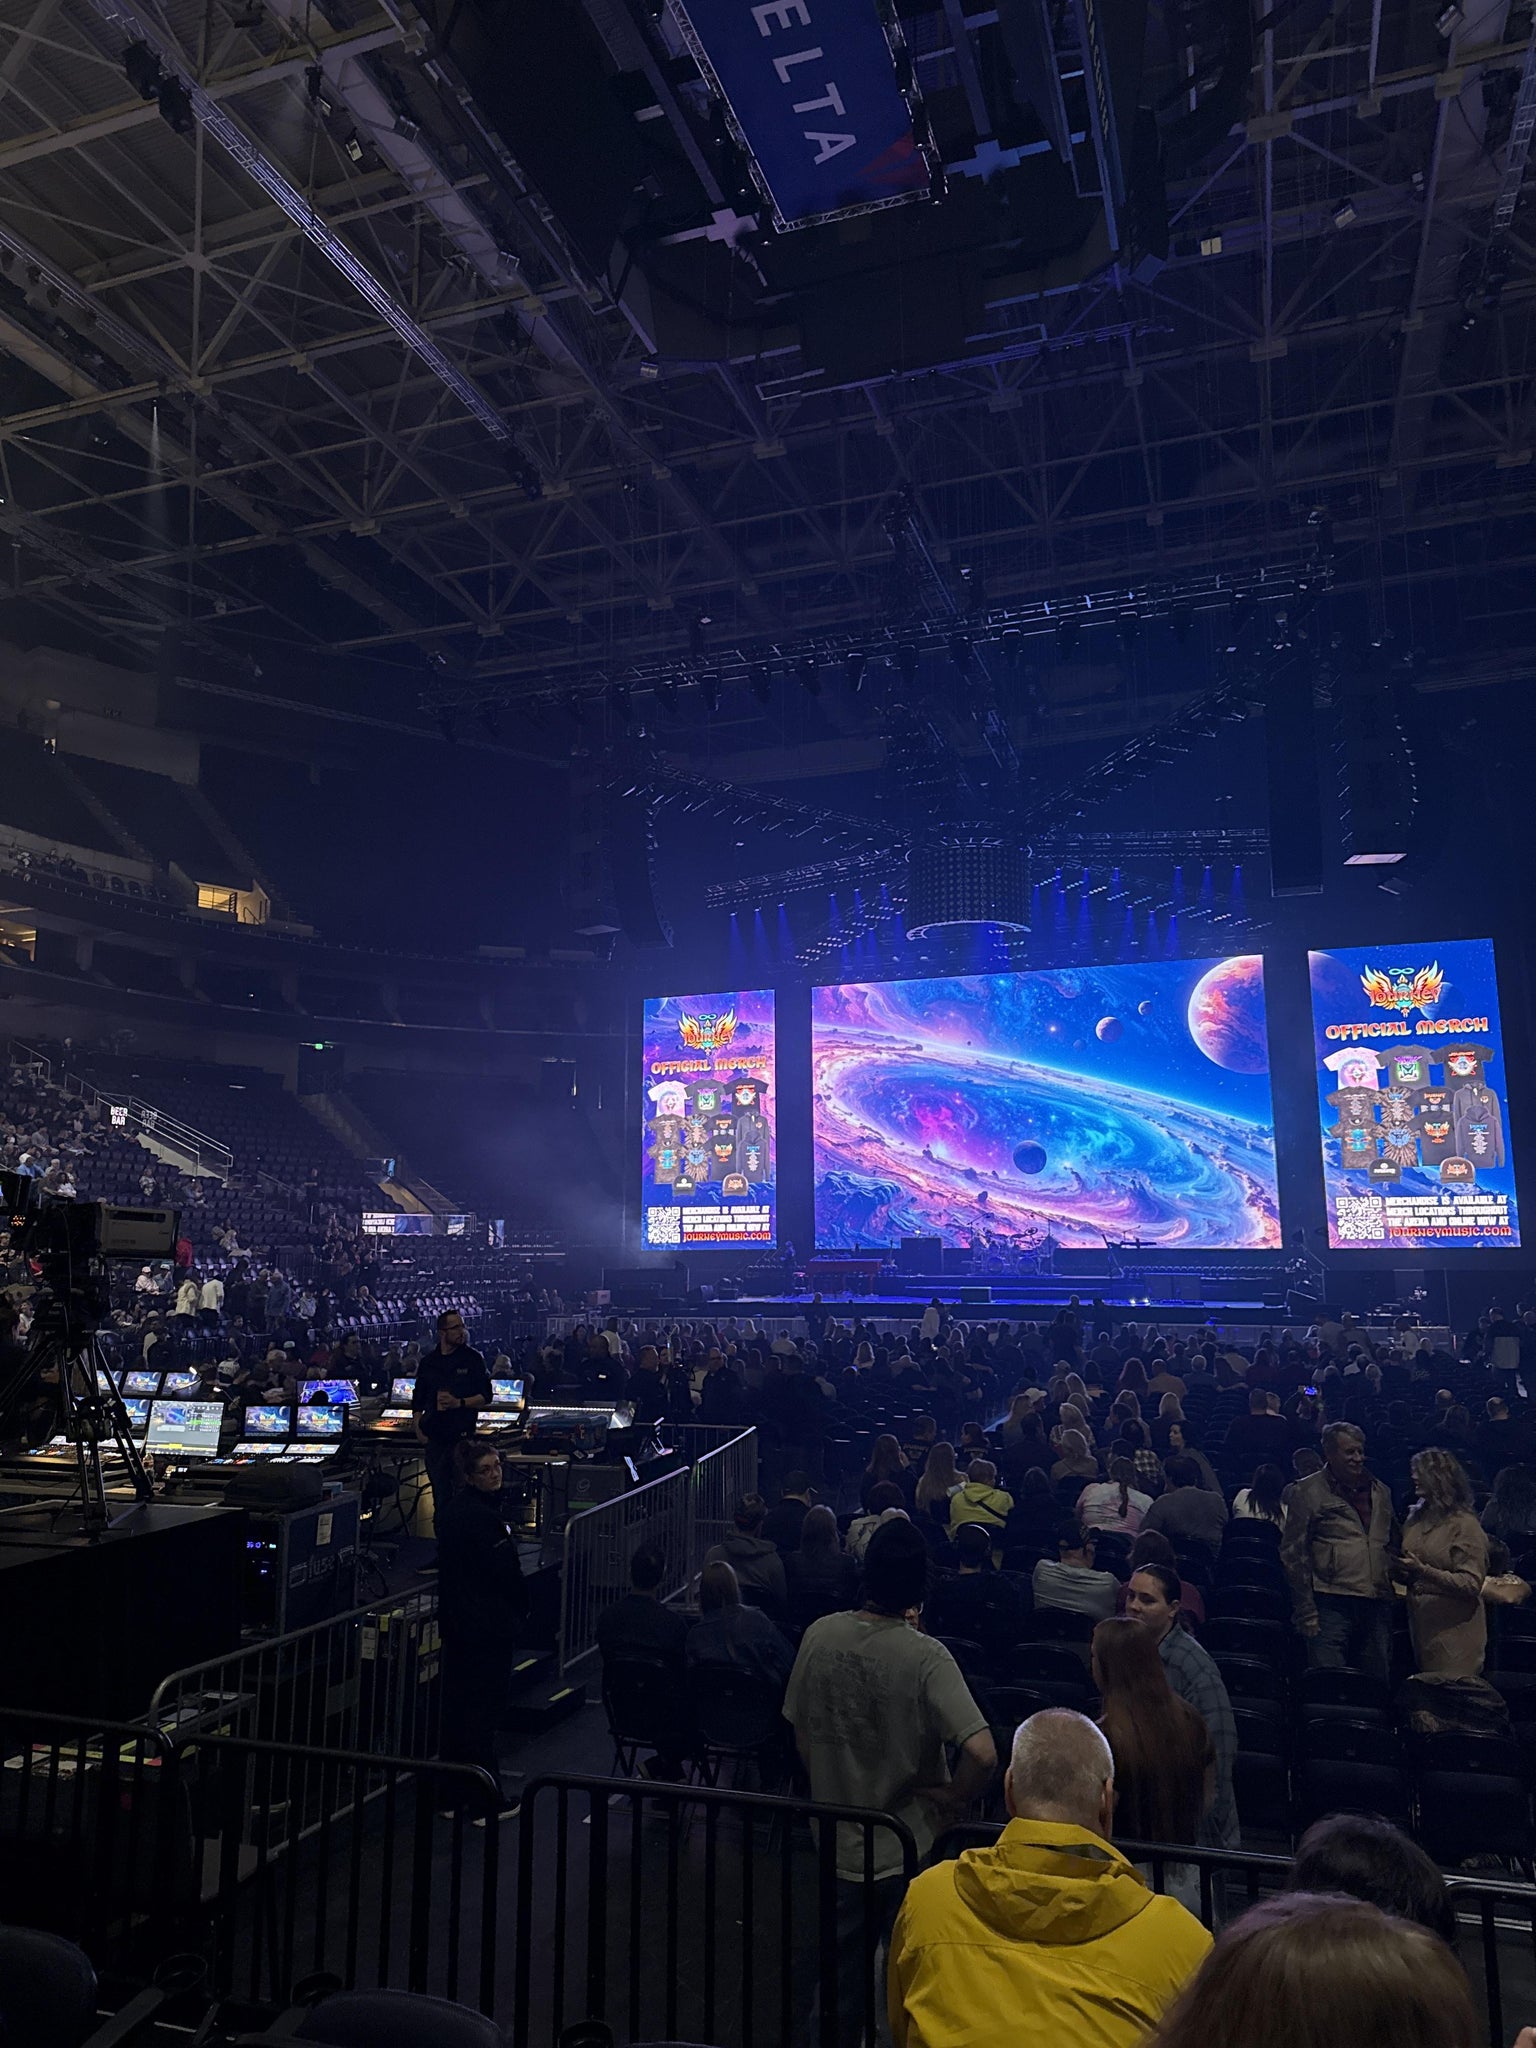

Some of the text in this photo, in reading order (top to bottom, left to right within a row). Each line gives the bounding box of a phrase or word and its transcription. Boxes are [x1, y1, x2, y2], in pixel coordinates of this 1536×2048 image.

[1369, 985, 1443, 1008] JOURNEY
[1325, 1017, 1489, 1041] OFFICIAL MERCH
[683, 1030, 733, 1047] JOURNEY
[650, 1055, 768, 1075] OFFICIAL MERCH
[110, 1106, 128, 1117] BEER
[111, 1115, 126, 1126] BAR
[1441, 1196, 1450, 1206] IS
[1453, 1195, 1494, 1205] AVAILABLE
[1496, 1195, 1508, 1205] AT
[1386, 1206, 1413, 1217] MERCH
[1414, 1206, 1456, 1216] LOCATIONS
[1387, 1217, 1402, 1227] THE
[1498, 1216, 1509, 1225] AT
